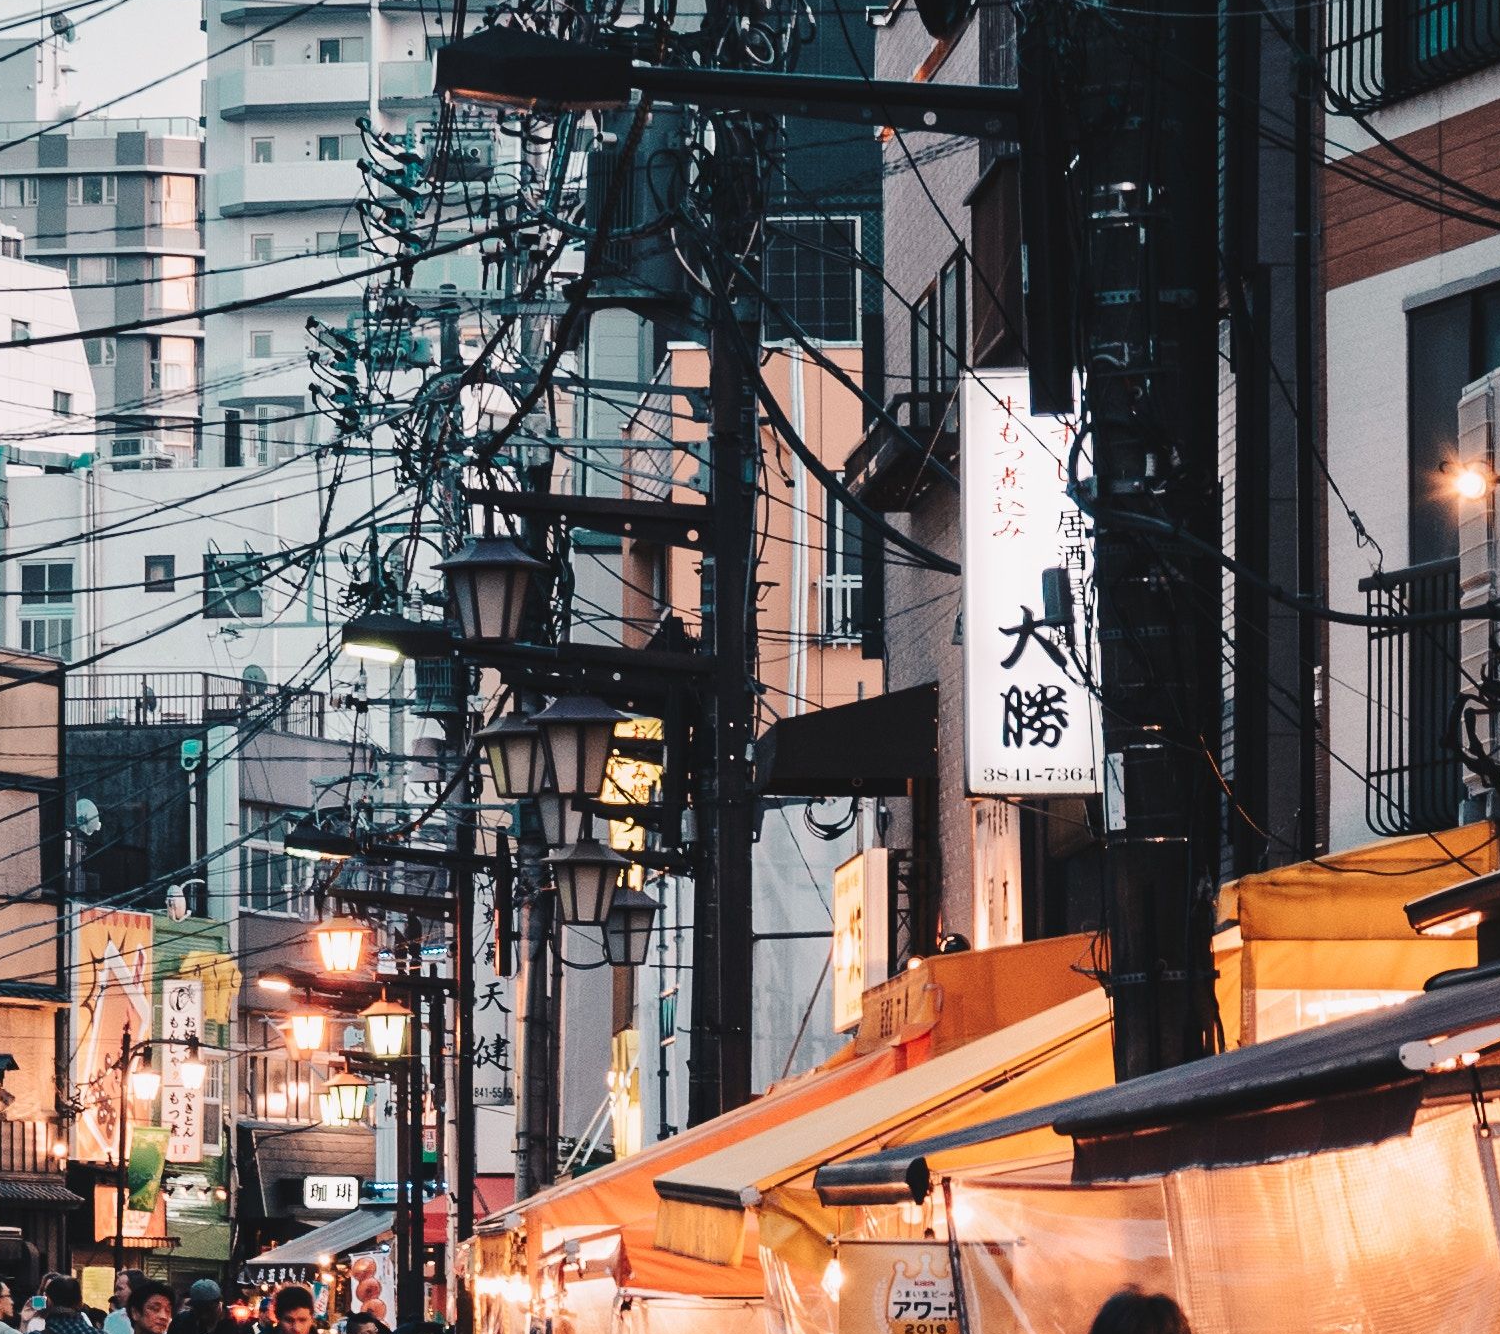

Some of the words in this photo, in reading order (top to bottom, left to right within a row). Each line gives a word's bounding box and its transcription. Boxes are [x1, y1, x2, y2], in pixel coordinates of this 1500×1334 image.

[998, 605, 1070, 749] 大勝
[983, 767, 1096, 783] 3841-7364
[904, 1323, 948, 1334] 2016
